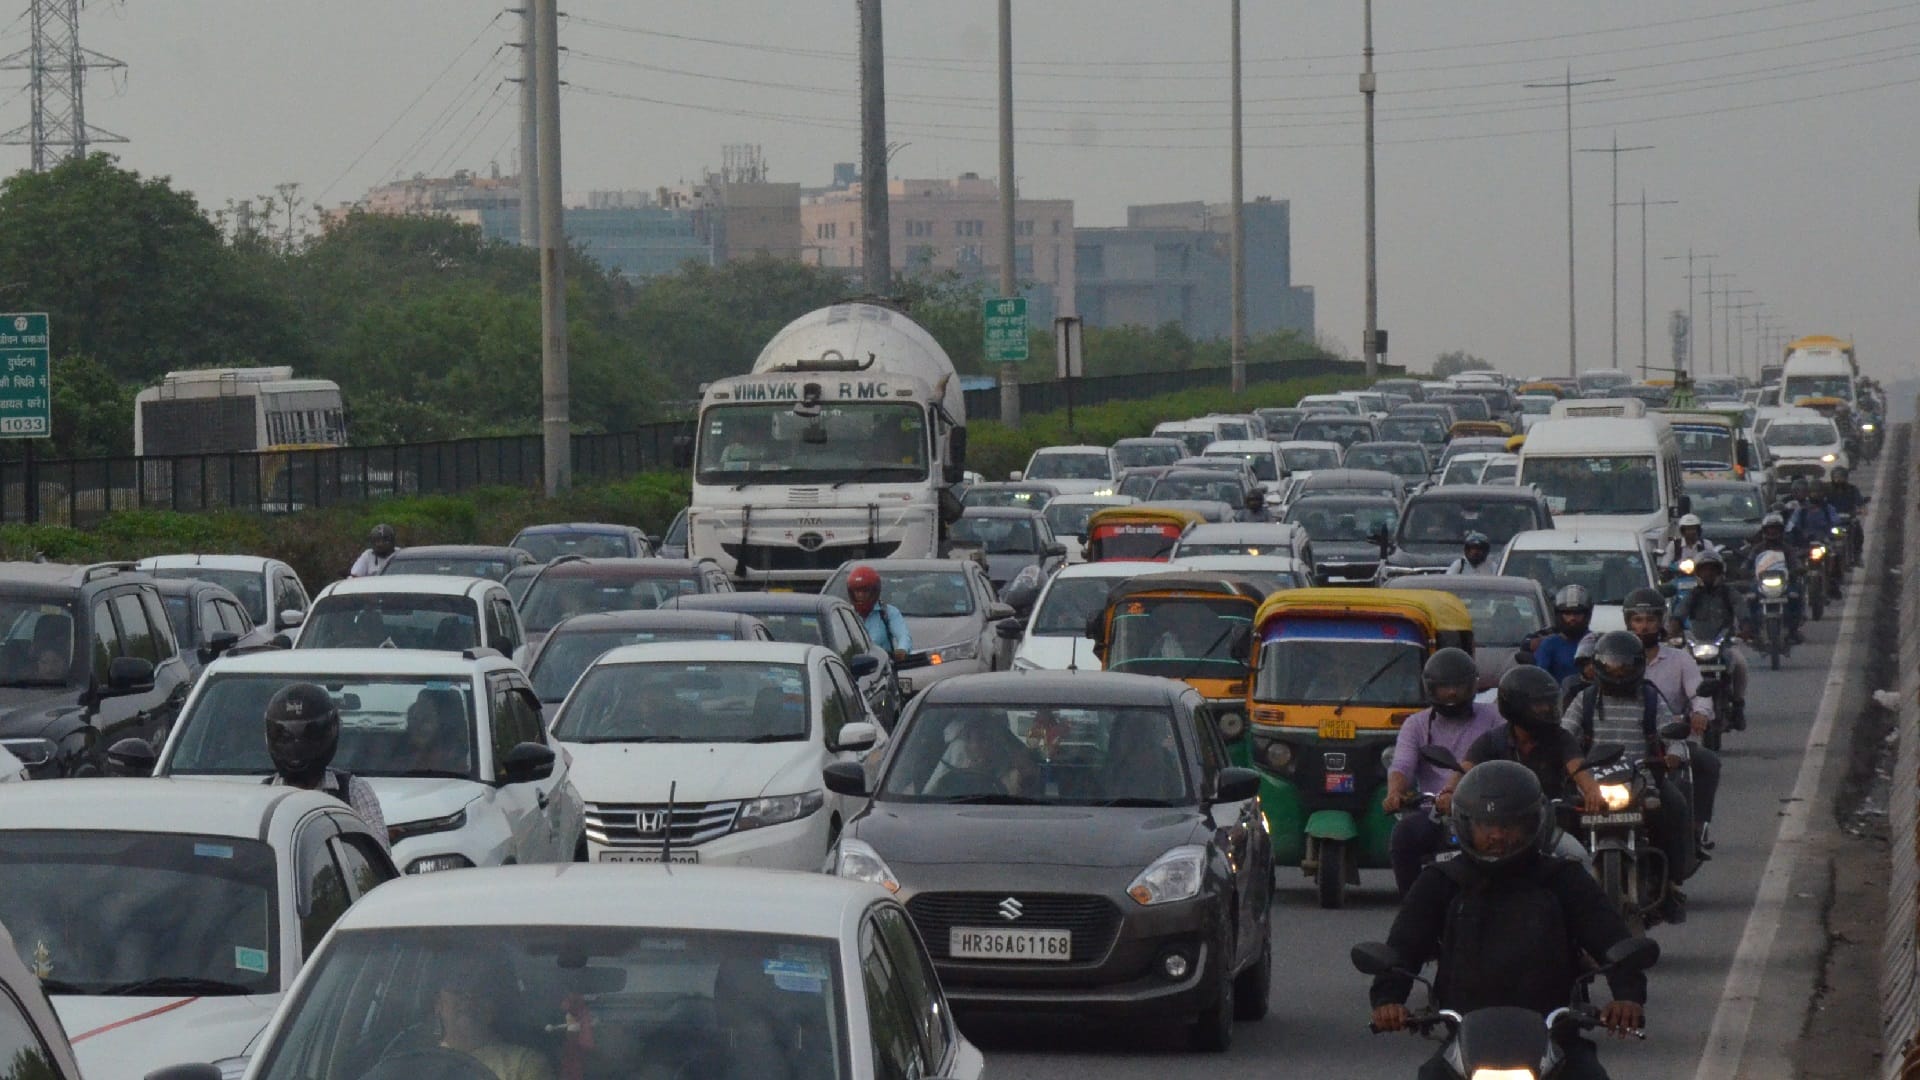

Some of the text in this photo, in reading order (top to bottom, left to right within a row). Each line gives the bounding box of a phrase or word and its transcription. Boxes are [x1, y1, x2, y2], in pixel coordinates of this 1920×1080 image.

[734, 382, 798, 400] VINAYAK
[6, 419, 42, 431] 1033
[799, 517, 823, 525] TATA
[962, 934, 1068, 954] HR36AG1168
